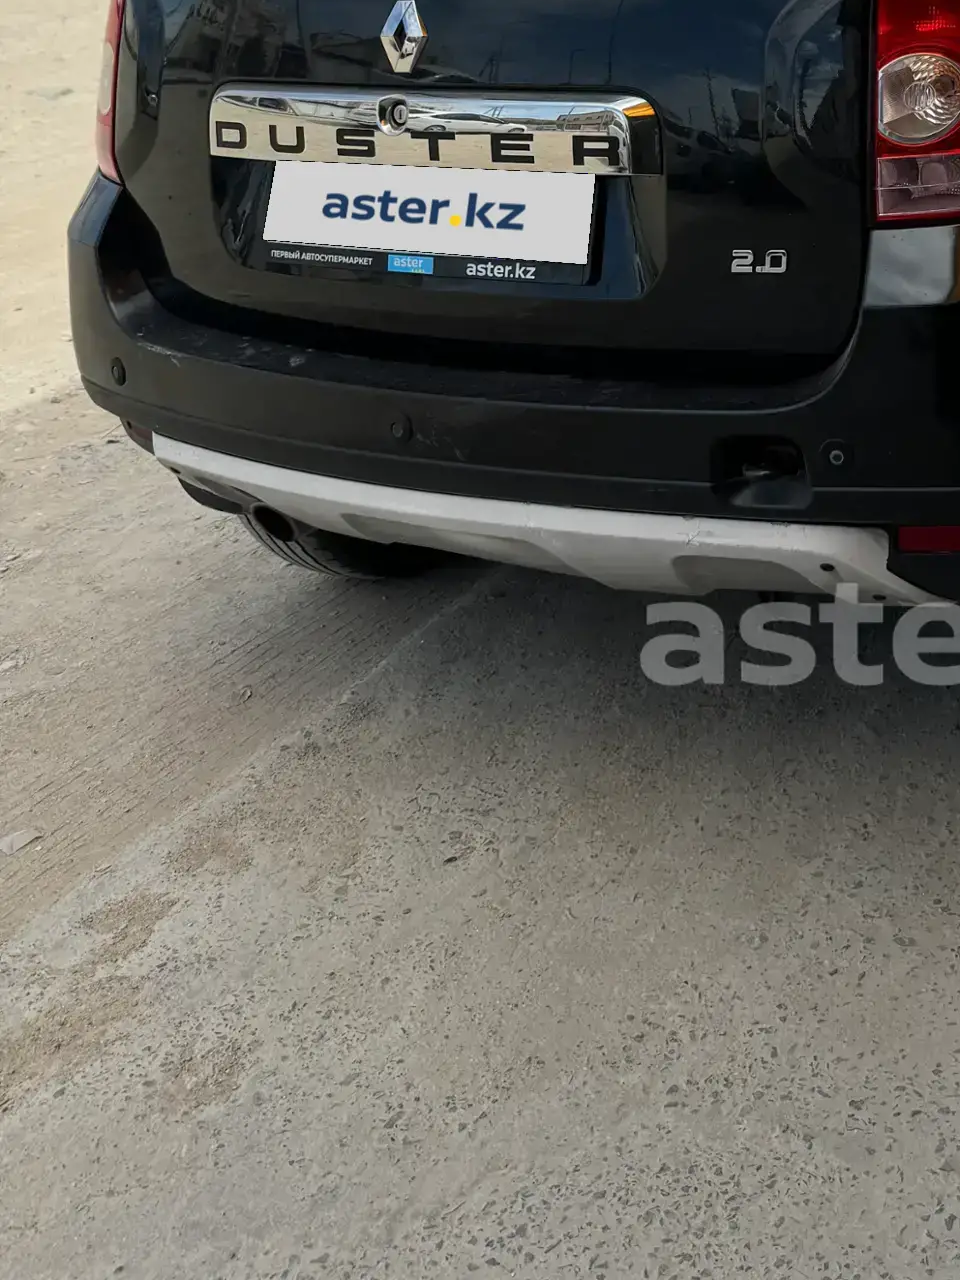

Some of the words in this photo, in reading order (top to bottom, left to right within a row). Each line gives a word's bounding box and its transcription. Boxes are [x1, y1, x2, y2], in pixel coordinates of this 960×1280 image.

[215, 121, 622, 166] DUSTER
[271, 248, 300, 260] ПЕРВЫЙ
[301, 252, 373, 266] АВТОСУПЕРМАРКЕТ
[393, 256, 423, 268] aster
[730, 249, 787, 274] 2.0
[466, 261, 536, 280] aster.kz
